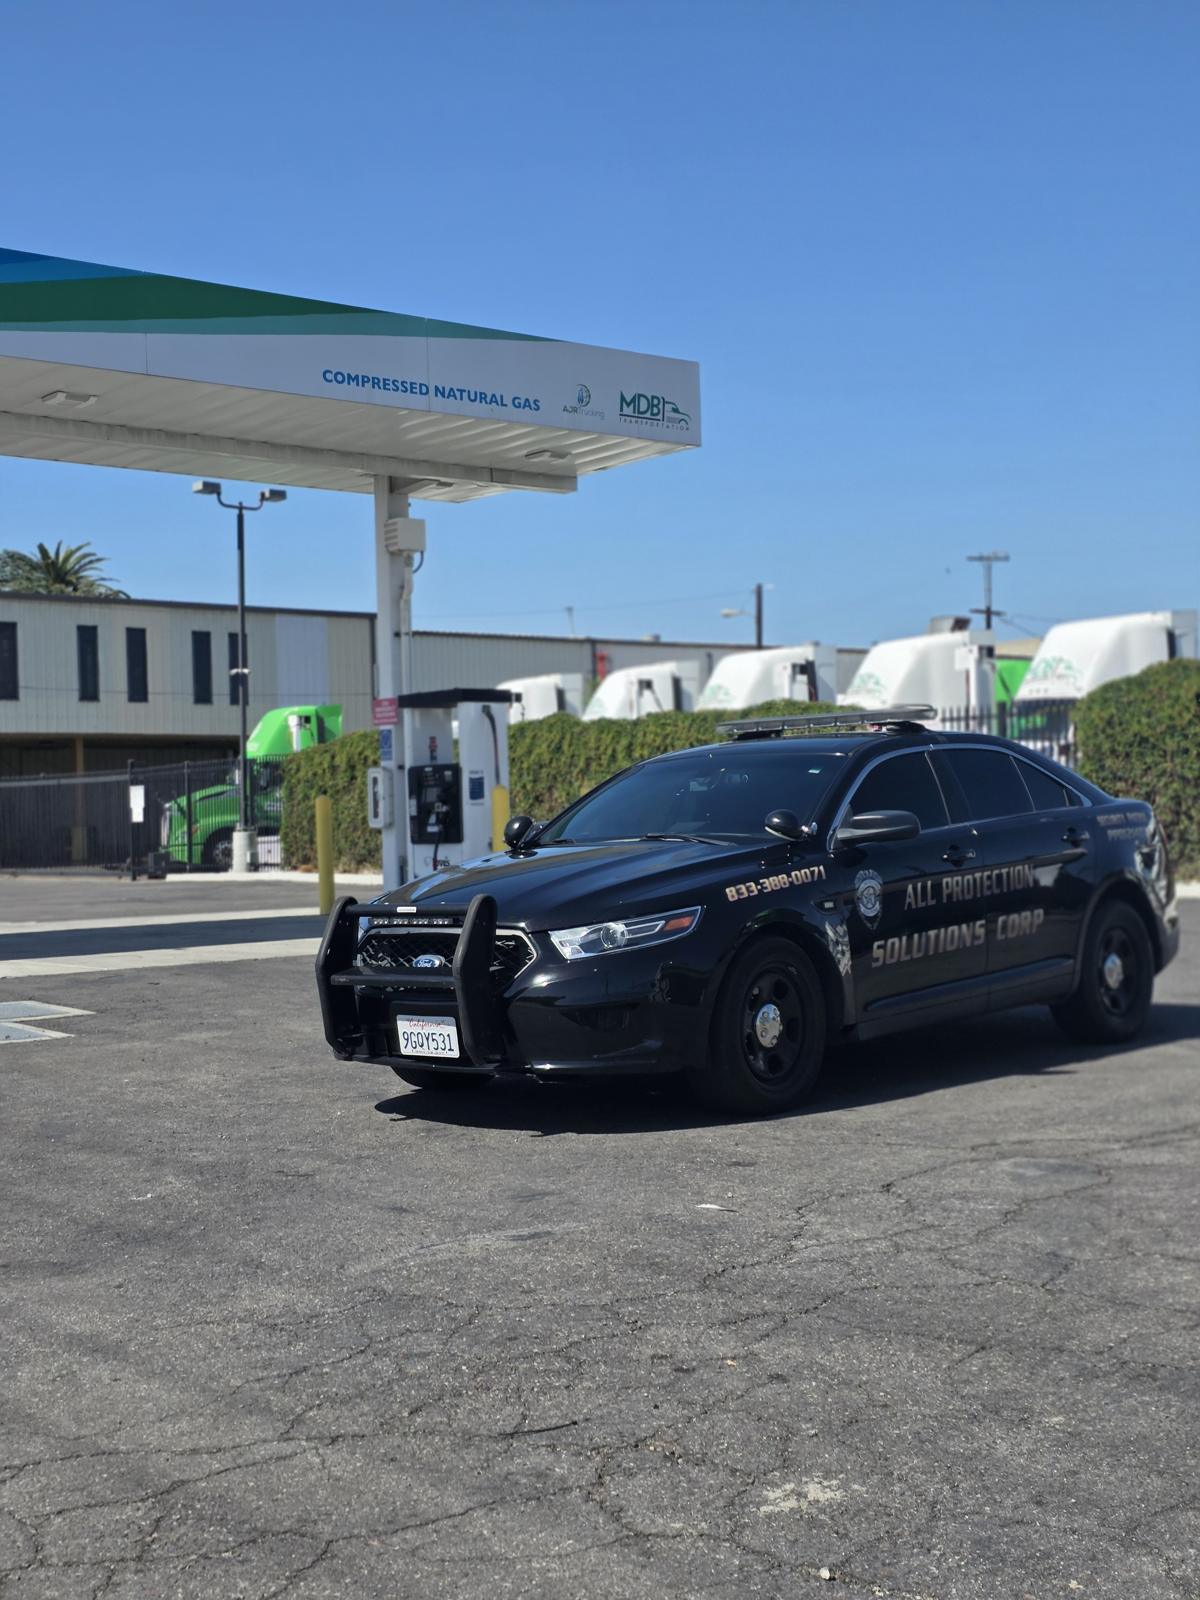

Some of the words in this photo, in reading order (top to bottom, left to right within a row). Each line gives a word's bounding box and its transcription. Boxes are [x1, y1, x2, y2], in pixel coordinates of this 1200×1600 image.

[322, 369, 429, 396] COMPRESSED
[434, 385, 508, 407] NATURAL
[512, 396, 541, 412] GAS
[619, 390, 662, 417] MDB
[619, 417, 690, 431] TRANSPORTATION
[725, 865, 826, 902] 833-388-0071
[904, 880, 936, 911] ALL
[942, 864, 1035, 903] PROTECTION
[872, 919, 986, 968] SOLUTIONS
[997, 908, 1044, 941] CORP
[417, 959, 433, 968] Ford
[402, 1030, 454, 1052] 9GQY531
